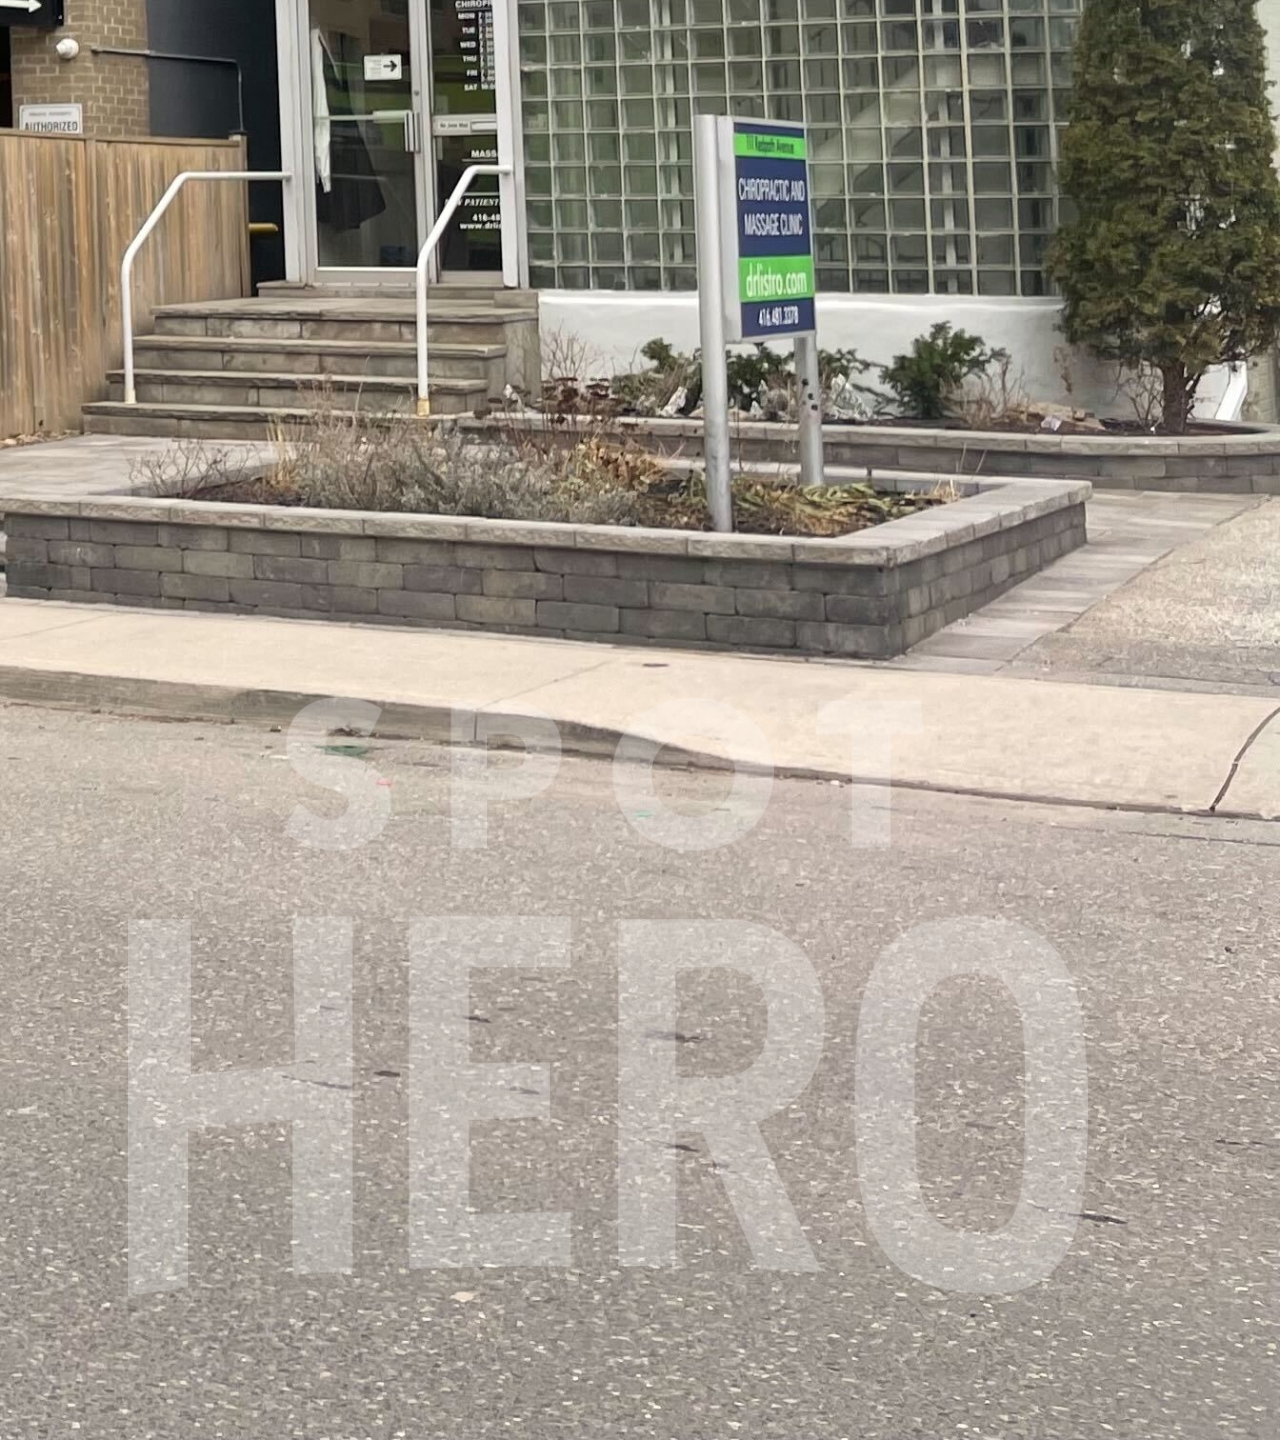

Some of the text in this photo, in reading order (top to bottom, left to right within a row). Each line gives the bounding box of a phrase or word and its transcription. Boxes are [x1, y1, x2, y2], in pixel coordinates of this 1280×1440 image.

[25, 121, 79, 132] AUTHORIZED
[738, 177, 805, 201] CHIROPRACTIC AND
[464, 198, 500, 206] PATIENT
[744, 213, 803, 236] MASSAGE CLINIC
[746, 262, 807, 297] drlistro.com
